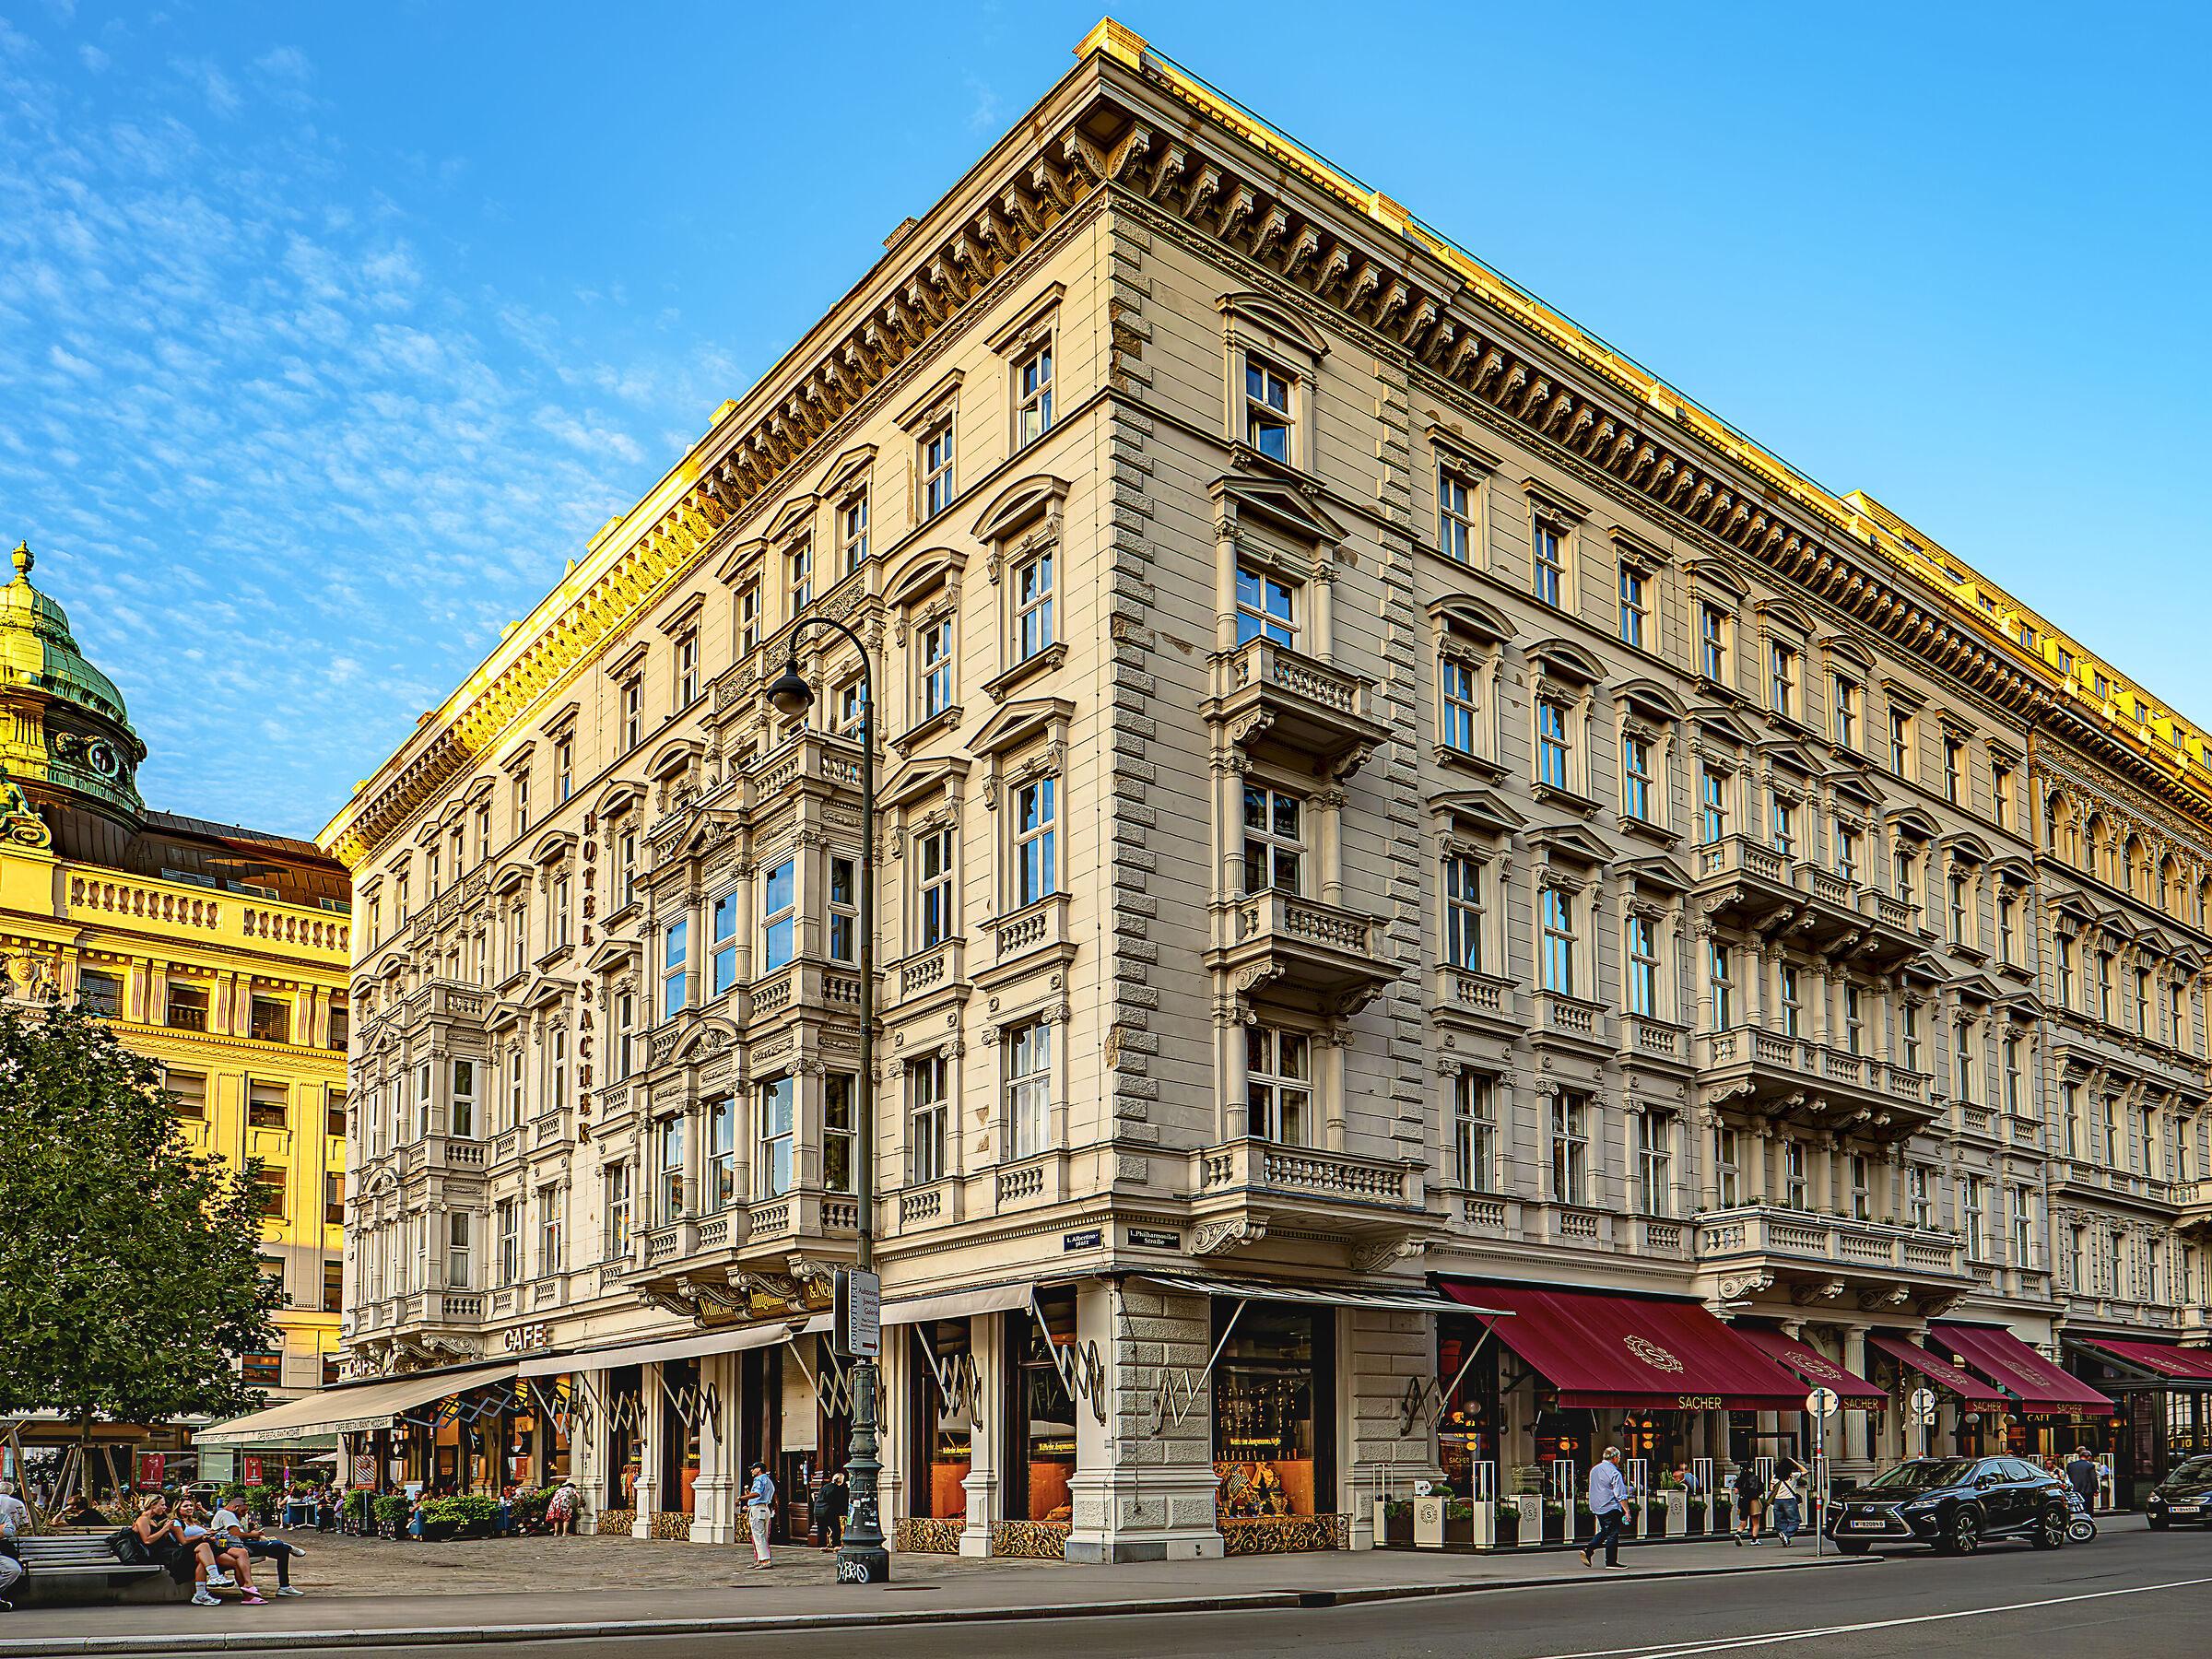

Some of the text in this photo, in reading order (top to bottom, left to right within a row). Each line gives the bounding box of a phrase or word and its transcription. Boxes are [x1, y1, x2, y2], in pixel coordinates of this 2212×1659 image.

[582, 811, 598, 949] HOTEL
[578, 979, 594, 1146] SACHER
[1677, 1396, 1722, 1409] SACHER
[1843, 1397, 1878, 1410] SACHER
[1972, 1401, 2002, 1412] SACHER
[2056, 1404, 2083, 1414] SACHER
